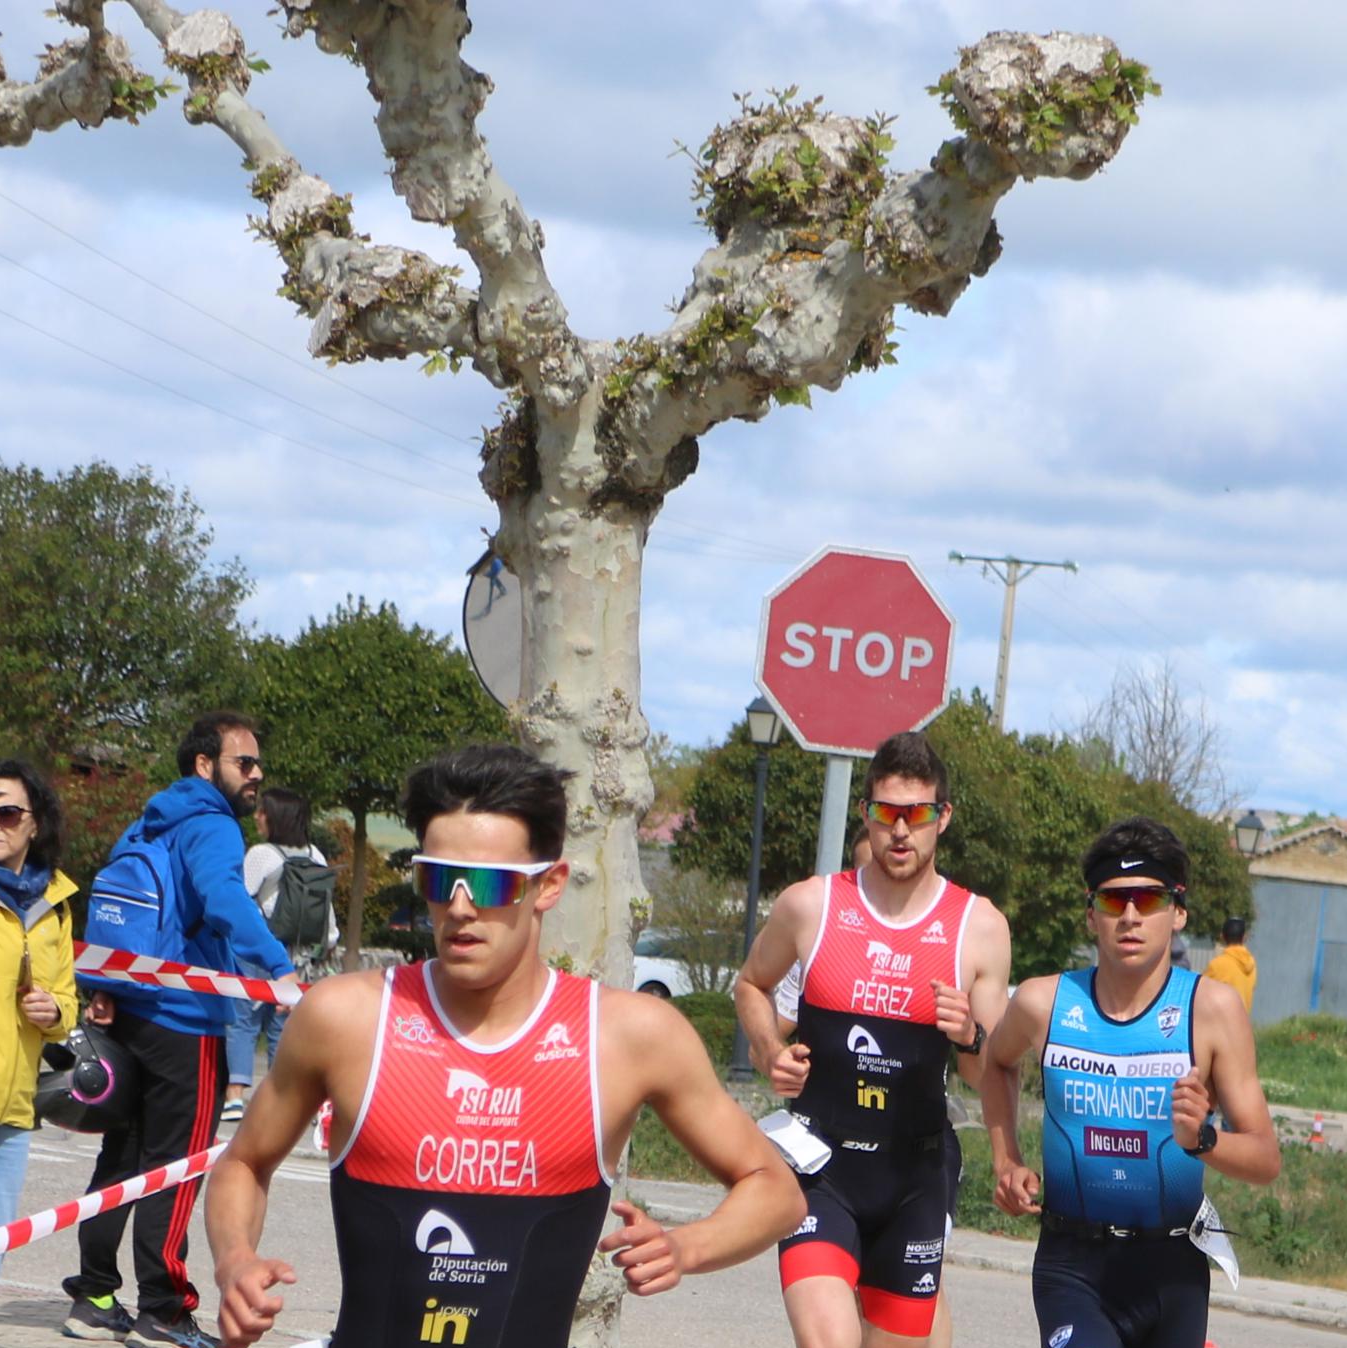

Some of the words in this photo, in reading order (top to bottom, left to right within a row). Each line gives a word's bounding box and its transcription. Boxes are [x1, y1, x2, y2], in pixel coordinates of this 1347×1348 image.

[780, 622, 933, 681] STOP
[851, 975, 914, 1018] PÉREZ
[534, 1046, 581, 1063] austral
[858, 1054, 903, 1068] Diputación
[1050, 1053, 1118, 1077] LAGUNA
[1126, 1062, 1185, 1077] DUERO
[856, 1063, 868, 1072] de
[869, 1065, 891, 1075] Soria
[460, 1087, 522, 1115] SORIA
[857, 1079, 885, 1110] in
[1064, 1078, 1168, 1121] FERNÁNDEZ
[1090, 1130, 1142, 1154] INGLAGO
[415, 1134, 538, 1188] CORREA
[431, 1255, 509, 1272] Diputación
[428, 1269, 446, 1282] de
[448, 1270, 486, 1284] Soria
[420, 1298, 469, 1345] in
[438, 1305, 479, 1318] JOVEN
